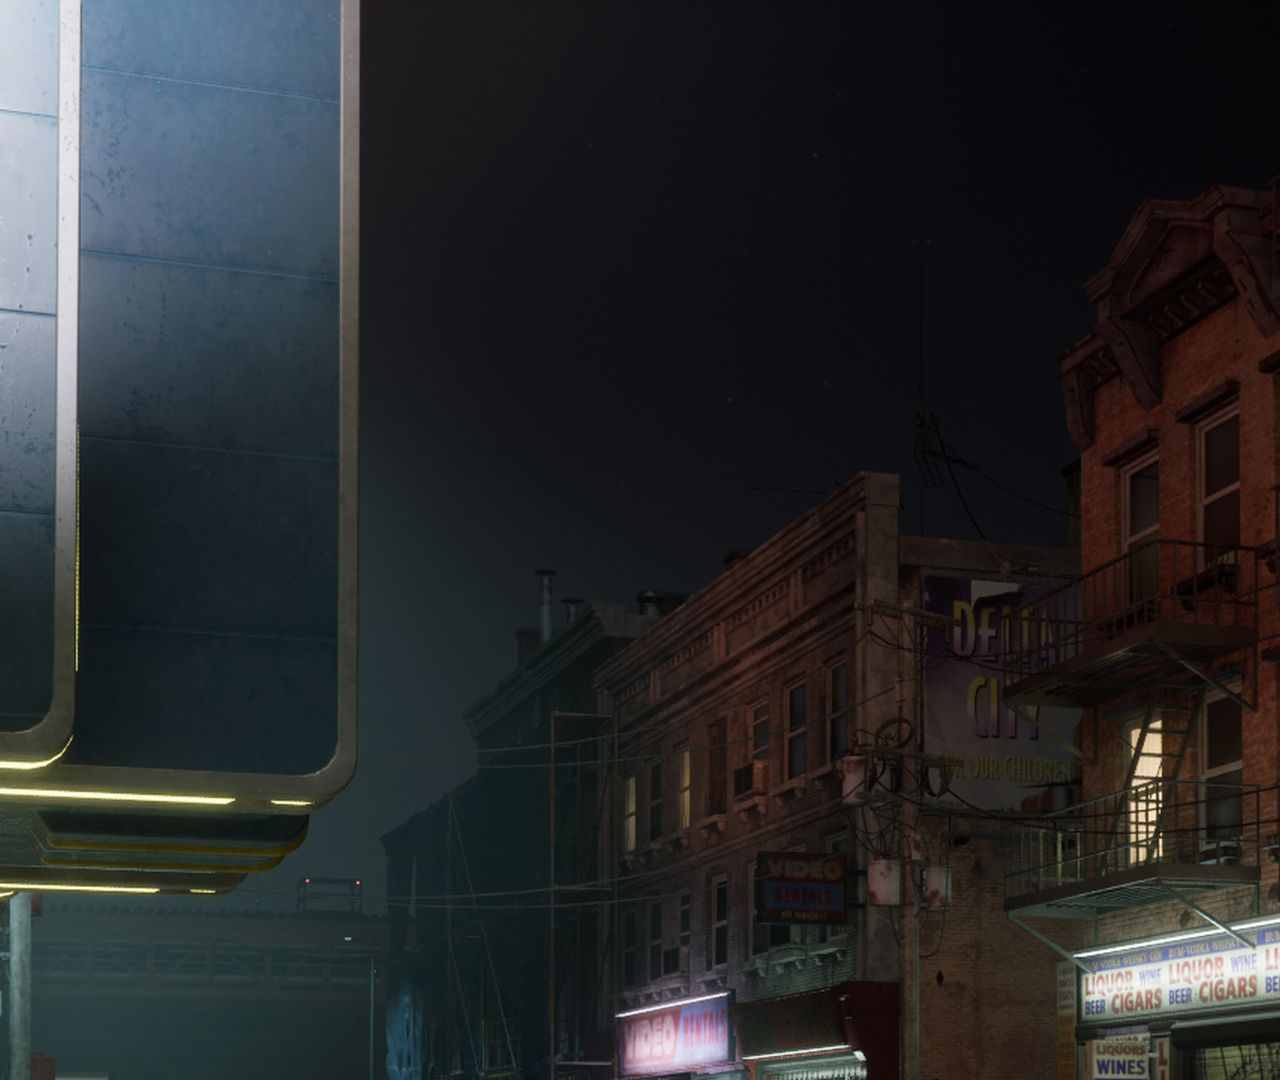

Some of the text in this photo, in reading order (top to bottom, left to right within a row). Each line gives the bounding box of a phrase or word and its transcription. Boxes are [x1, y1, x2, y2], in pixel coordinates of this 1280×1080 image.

[768, 859, 843, 880] VIDEO
[1085, 970, 1133, 997] LIQUOR
[1139, 968, 1163, 986] WINE
[1169, 956, 1225, 985] LIQUOR
[1231, 953, 1258, 973] WINE
[1085, 1000, 1106, 1016] BEER
[1111, 987, 1163, 1014] CIGARS
[1169, 987, 1193, 1005] BEER
[1199, 975, 1258, 1004] CIGARS
[624, 1013, 676, 1060] VIDEO
[1096, 1042, 1147, 1056] LIQUORS
[1096, 1058, 1147, 1075] WINES
